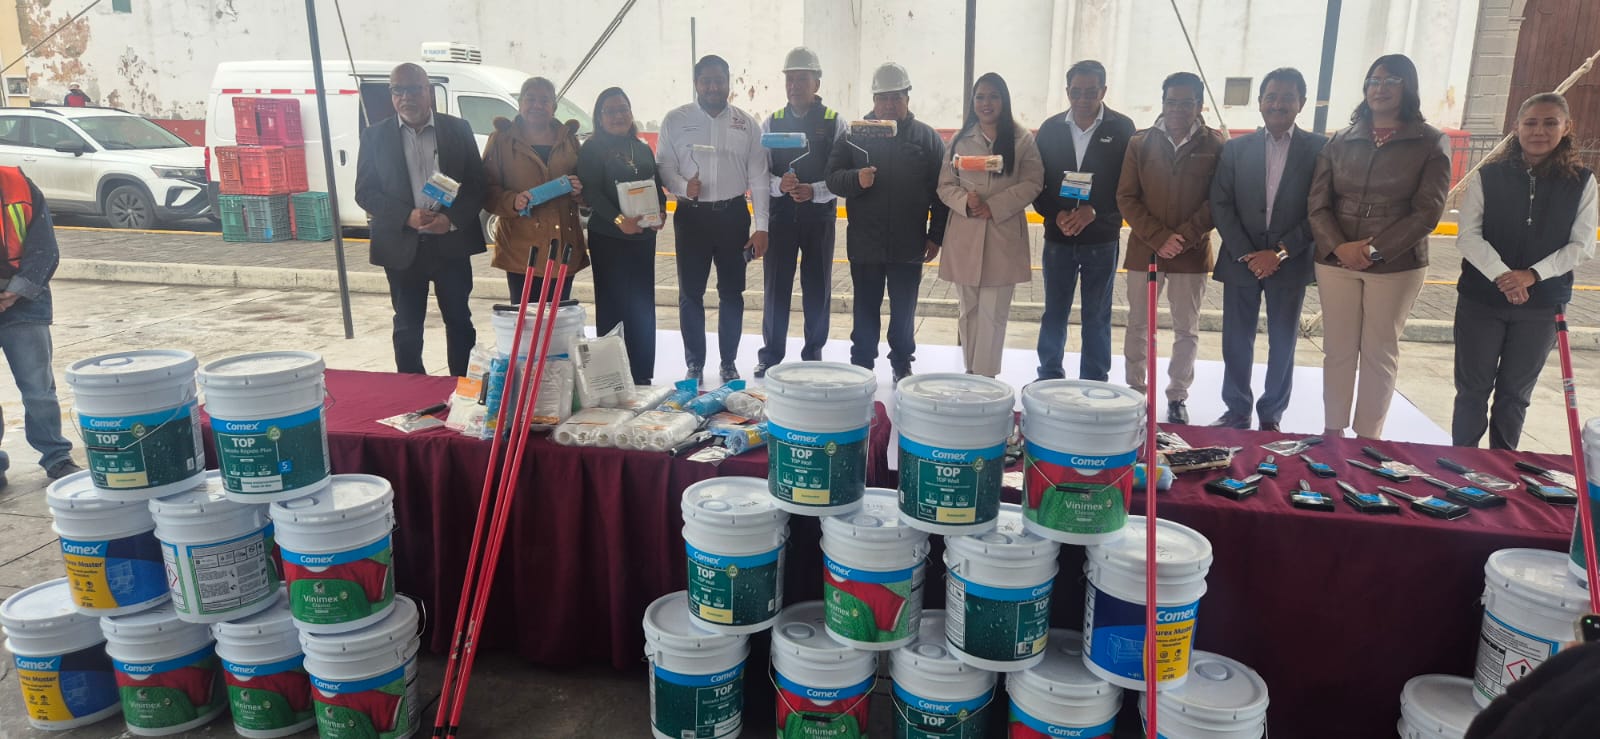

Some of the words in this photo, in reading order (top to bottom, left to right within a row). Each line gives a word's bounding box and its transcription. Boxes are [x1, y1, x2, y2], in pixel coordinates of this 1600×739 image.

[90, 419, 123, 428] Comex
[226, 422, 260, 430] Comex
[96, 434, 119, 444] TOP
[231, 438, 256, 448] TOP
[786, 432, 820, 443] Comex
[790, 447, 813, 459] TOP
[932, 450, 968, 460] Comex
[1070, 456, 1108, 466] Comex
[936, 466, 960, 477] TOP
[1065, 500, 1103, 511] Vinimex
[62, 542, 102, 554] Comex
[300, 554, 336, 563] Comex
[694, 551, 720, 564] Comex
[696, 566, 715, 580] TOP
[827, 560, 851, 576] Comex
[304, 595, 338, 603] Vinimex
[1034, 597, 1049, 612] TOP
[1156, 604, 1198, 622] Comex
[16, 658, 56, 669] Comex
[124, 664, 156, 672] Comex
[229, 664, 257, 673] Comex
[710, 668, 737, 682] Comex
[314, 679, 342, 690] Comex
[714, 684, 733, 697] TOP
[806, 689, 840, 697] Comex
[918, 700, 952, 711] Comex
[922, 714, 946, 726] TOP
[804, 726, 837, 735] Vinimex
[1048, 726, 1084, 737] Comex
